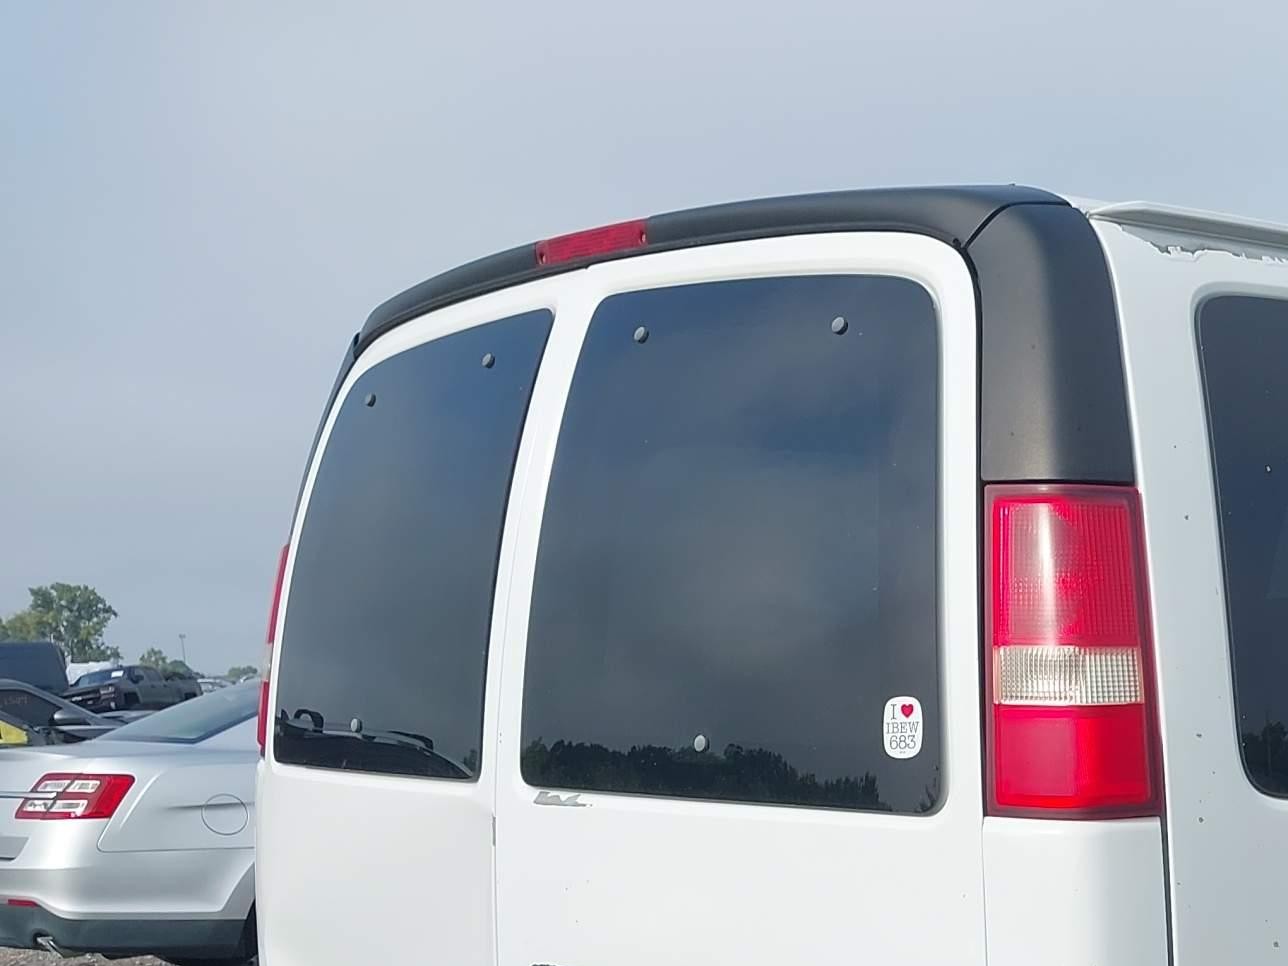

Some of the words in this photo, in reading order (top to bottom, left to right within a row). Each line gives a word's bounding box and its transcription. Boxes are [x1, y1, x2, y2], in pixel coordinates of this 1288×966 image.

[890, 704, 897, 720] I
[886, 721, 920, 734] IBEW
[889, 735, 916, 750] 683
